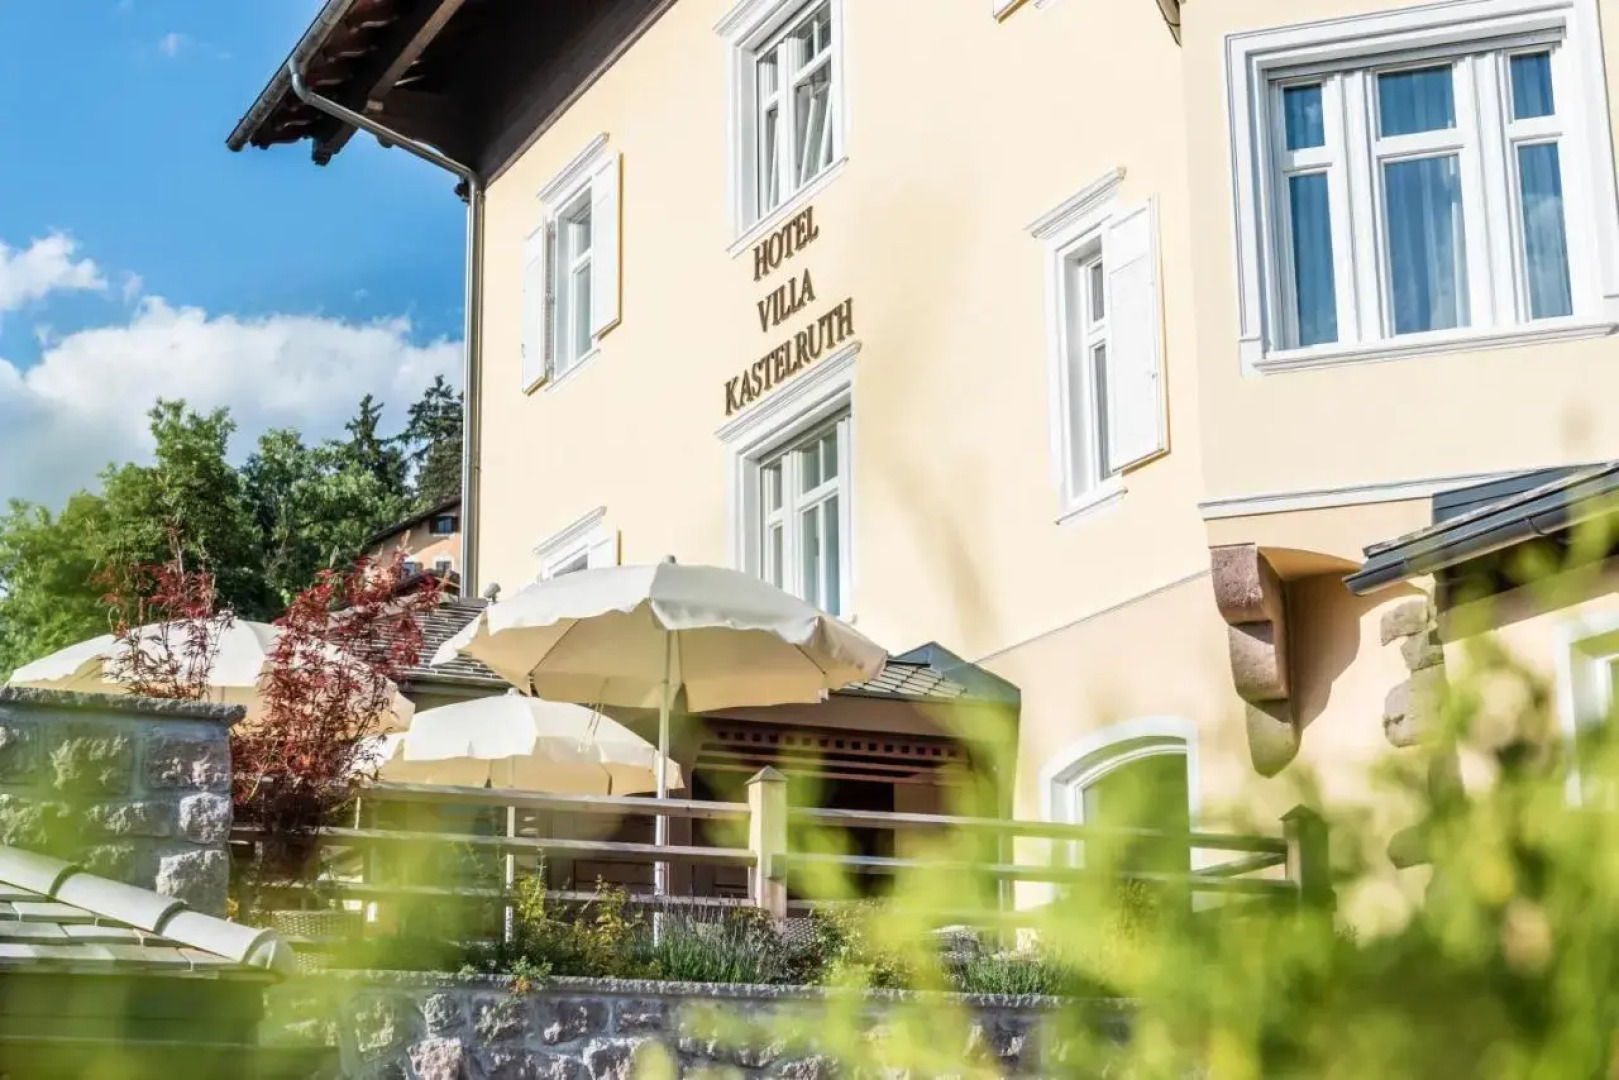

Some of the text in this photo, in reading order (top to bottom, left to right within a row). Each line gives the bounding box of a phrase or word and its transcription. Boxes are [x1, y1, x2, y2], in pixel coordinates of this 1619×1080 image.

[753, 206, 819, 282] HOTEL
[757, 268, 816, 333] VILLA
[724, 297, 855, 416] KASTELRUTH
